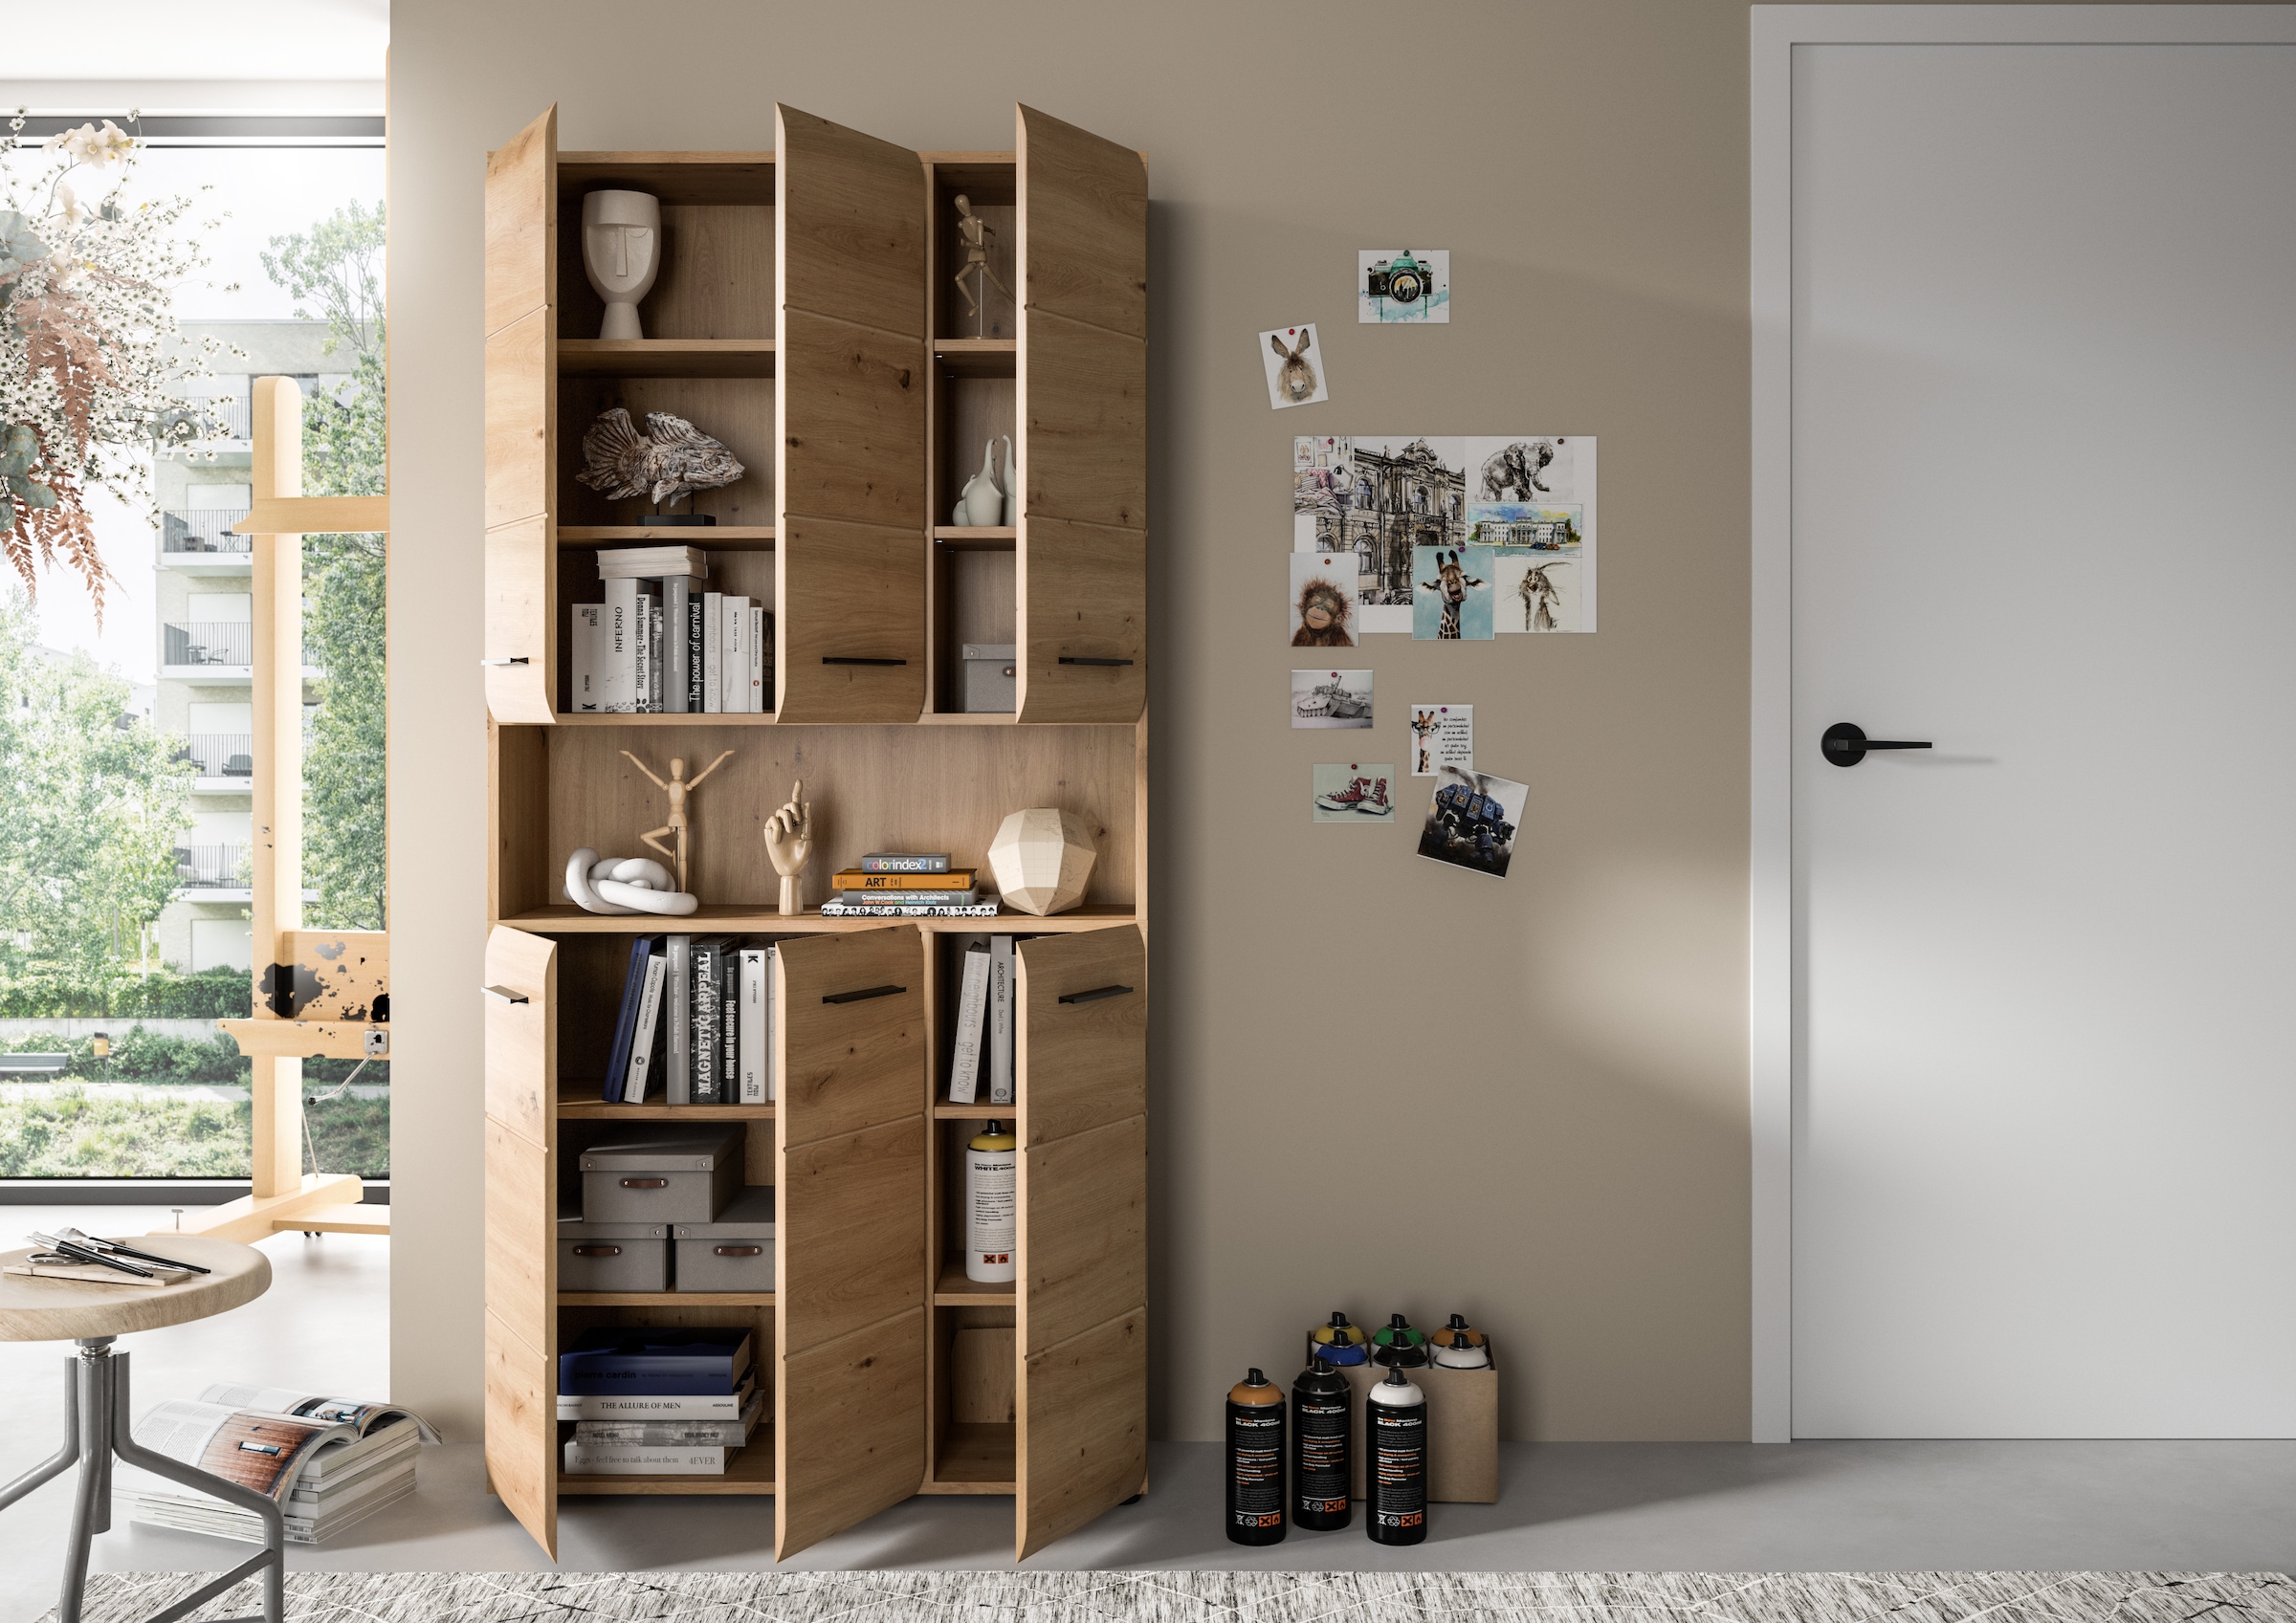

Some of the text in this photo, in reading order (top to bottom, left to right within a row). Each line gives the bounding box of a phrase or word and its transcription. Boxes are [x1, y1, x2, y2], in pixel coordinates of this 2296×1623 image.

[614, 606, 623, 653] INFERNO
[707, 612, 718, 653] neighbours
[636, 597, 646, 690] Donna Summer The Secret Story
[689, 603, 704, 702] The power of carnival
[707, 664, 718, 677] get
[865, 877, 887, 888] ART
[748, 954, 758, 964] K
[972, 957, 985, 977] Your
[725, 1000, 736, 1014] Feel
[964, 977, 982, 1027] neighbours
[725, 1014, 736, 1037] secure
[697, 1014, 712, 1095] MAGNETIC
[725, 1043, 736, 1060] your
[959, 1042, 974, 1058] get
[725, 1060, 736, 1079] house
[958, 1068, 974, 1094] know
[574, 1371, 635, 1381] pierre cardin
[575, 1456, 591, 1465] Eggs
[688, 1457, 716, 1465] 4EVER
